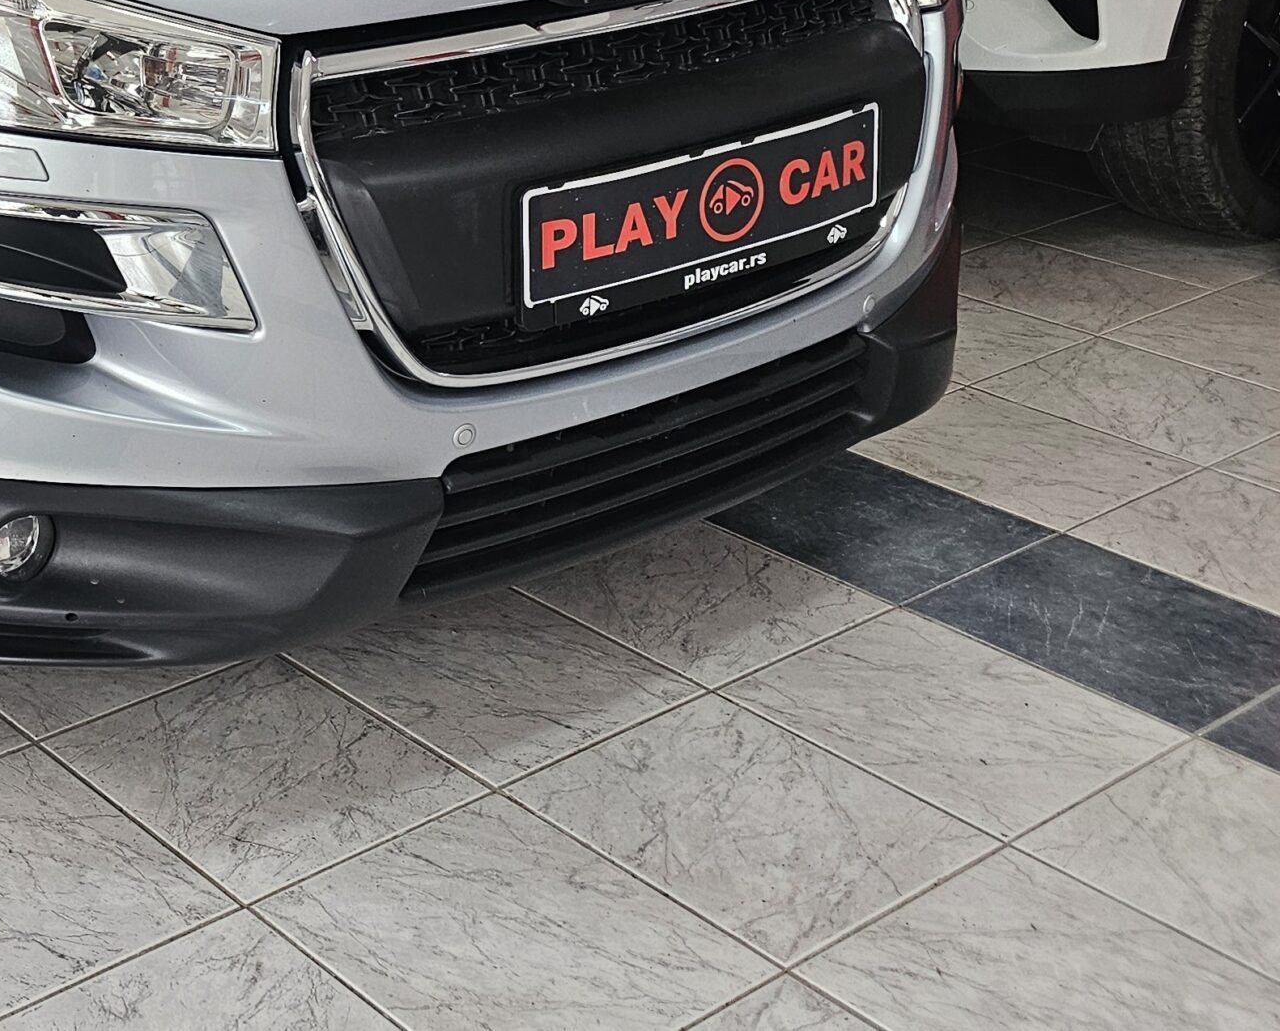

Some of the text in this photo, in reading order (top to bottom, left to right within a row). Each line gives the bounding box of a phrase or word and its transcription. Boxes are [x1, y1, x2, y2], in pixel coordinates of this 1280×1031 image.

[541, 139, 866, 270] PLAY CAR
[684, 252, 766, 290] playcar.rs
